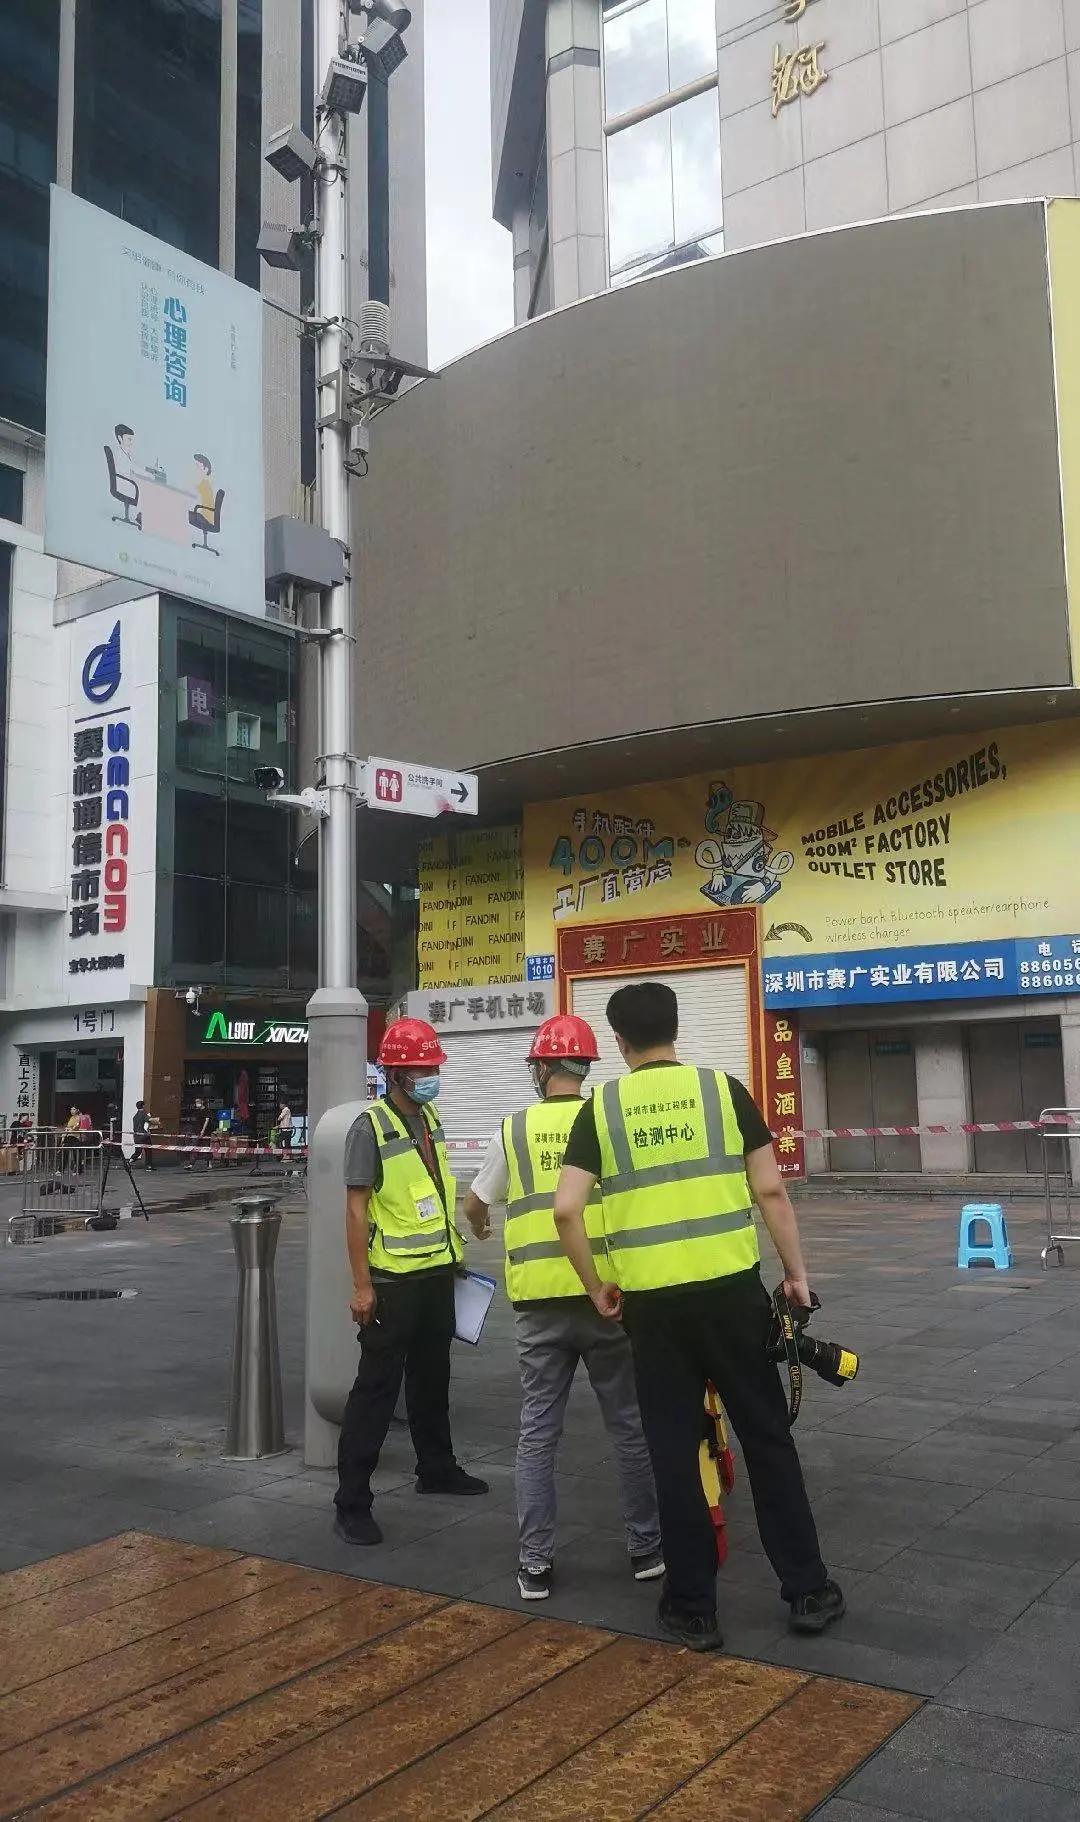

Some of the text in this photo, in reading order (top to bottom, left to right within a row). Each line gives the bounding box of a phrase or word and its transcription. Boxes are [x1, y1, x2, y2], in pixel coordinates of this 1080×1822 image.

[164, 296, 188, 408] 心理咨询
[191, 688, 210, 716] 电
[407, 773, 443, 788] 公共洗手间
[801, 741, 1007, 845] MOBILE ACCESSORIES,
[69, 726, 104, 939] 赛格通信市场
[572, 808, 656, 837] 手机配件
[864, 812, 951, 854] FACTORY
[465, 872, 501, 886] FANDINI
[807, 857, 947, 887] OUTLET STORE
[552, 858, 673, 921] 工厂直营店
[465, 913, 500, 926] FANDINI
[488, 931, 523, 944] FANDINI
[583, 922, 729, 964] 赛广实业
[870, 926, 910, 942] charger
[467, 954, 501, 967] FANDINI
[532, 964, 553, 976] 1010
[764, 957, 1004, 993] 深圳市赛广实业有限公司
[73, 1009, 115, 1033] 1号门
[428, 992, 545, 1023] 赛广手机市场
[17, 1054, 31, 1108] 直上2楼
[625, 1099, 697, 1117] 深圳市建设工程质量
[633, 1123, 695, 1148] 检测中心
[783, 1314, 794, 1340] Nikon
